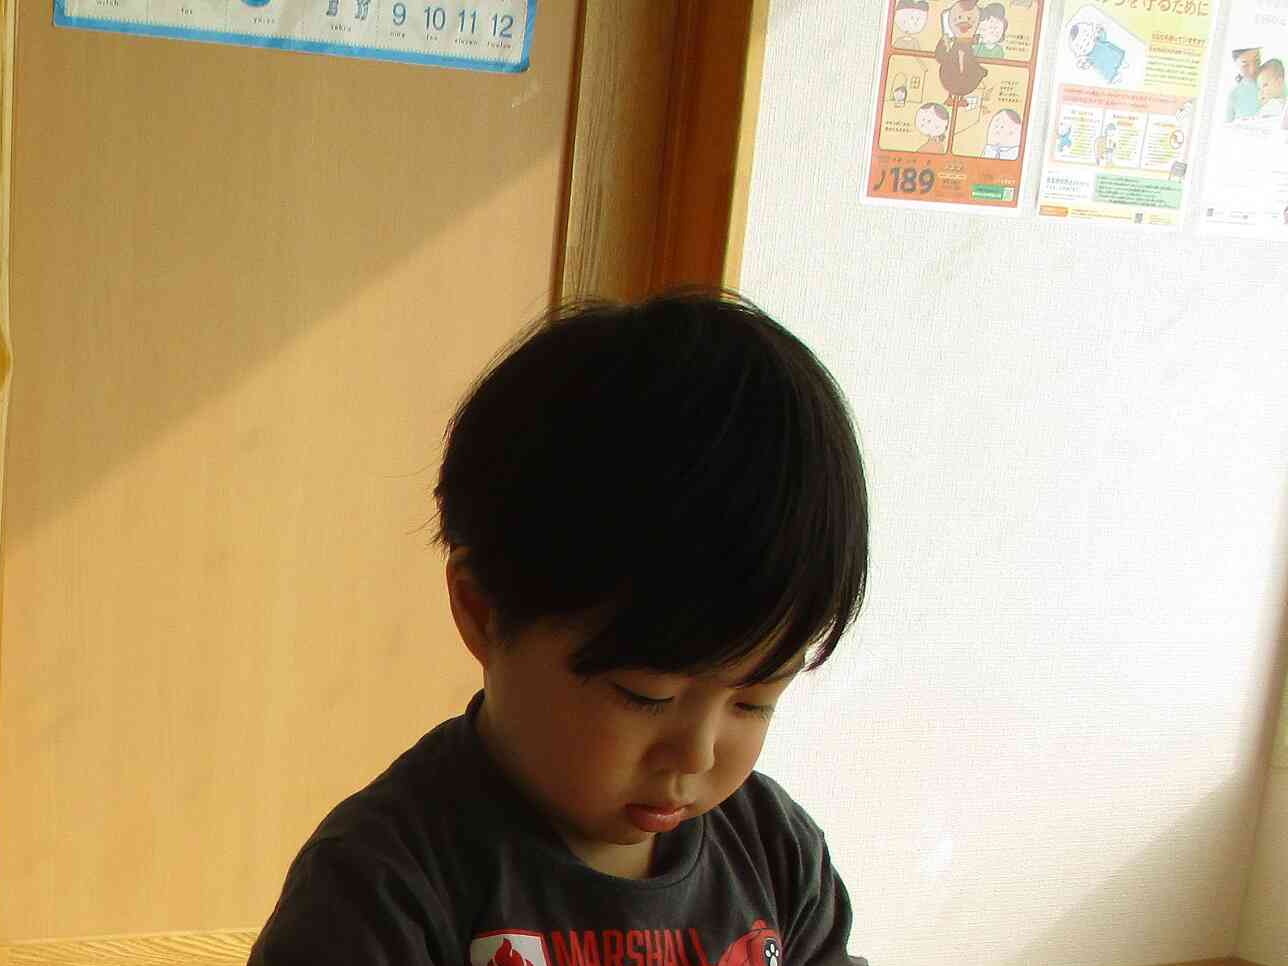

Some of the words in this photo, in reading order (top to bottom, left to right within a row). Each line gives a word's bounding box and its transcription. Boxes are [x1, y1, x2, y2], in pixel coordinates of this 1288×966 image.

[392, 2, 407, 27] 9
[423, 6, 446, 31] 10
[457, 8, 478, 35] 11
[491, 13, 514, 39] 12
[890, 168, 935, 193] 189
